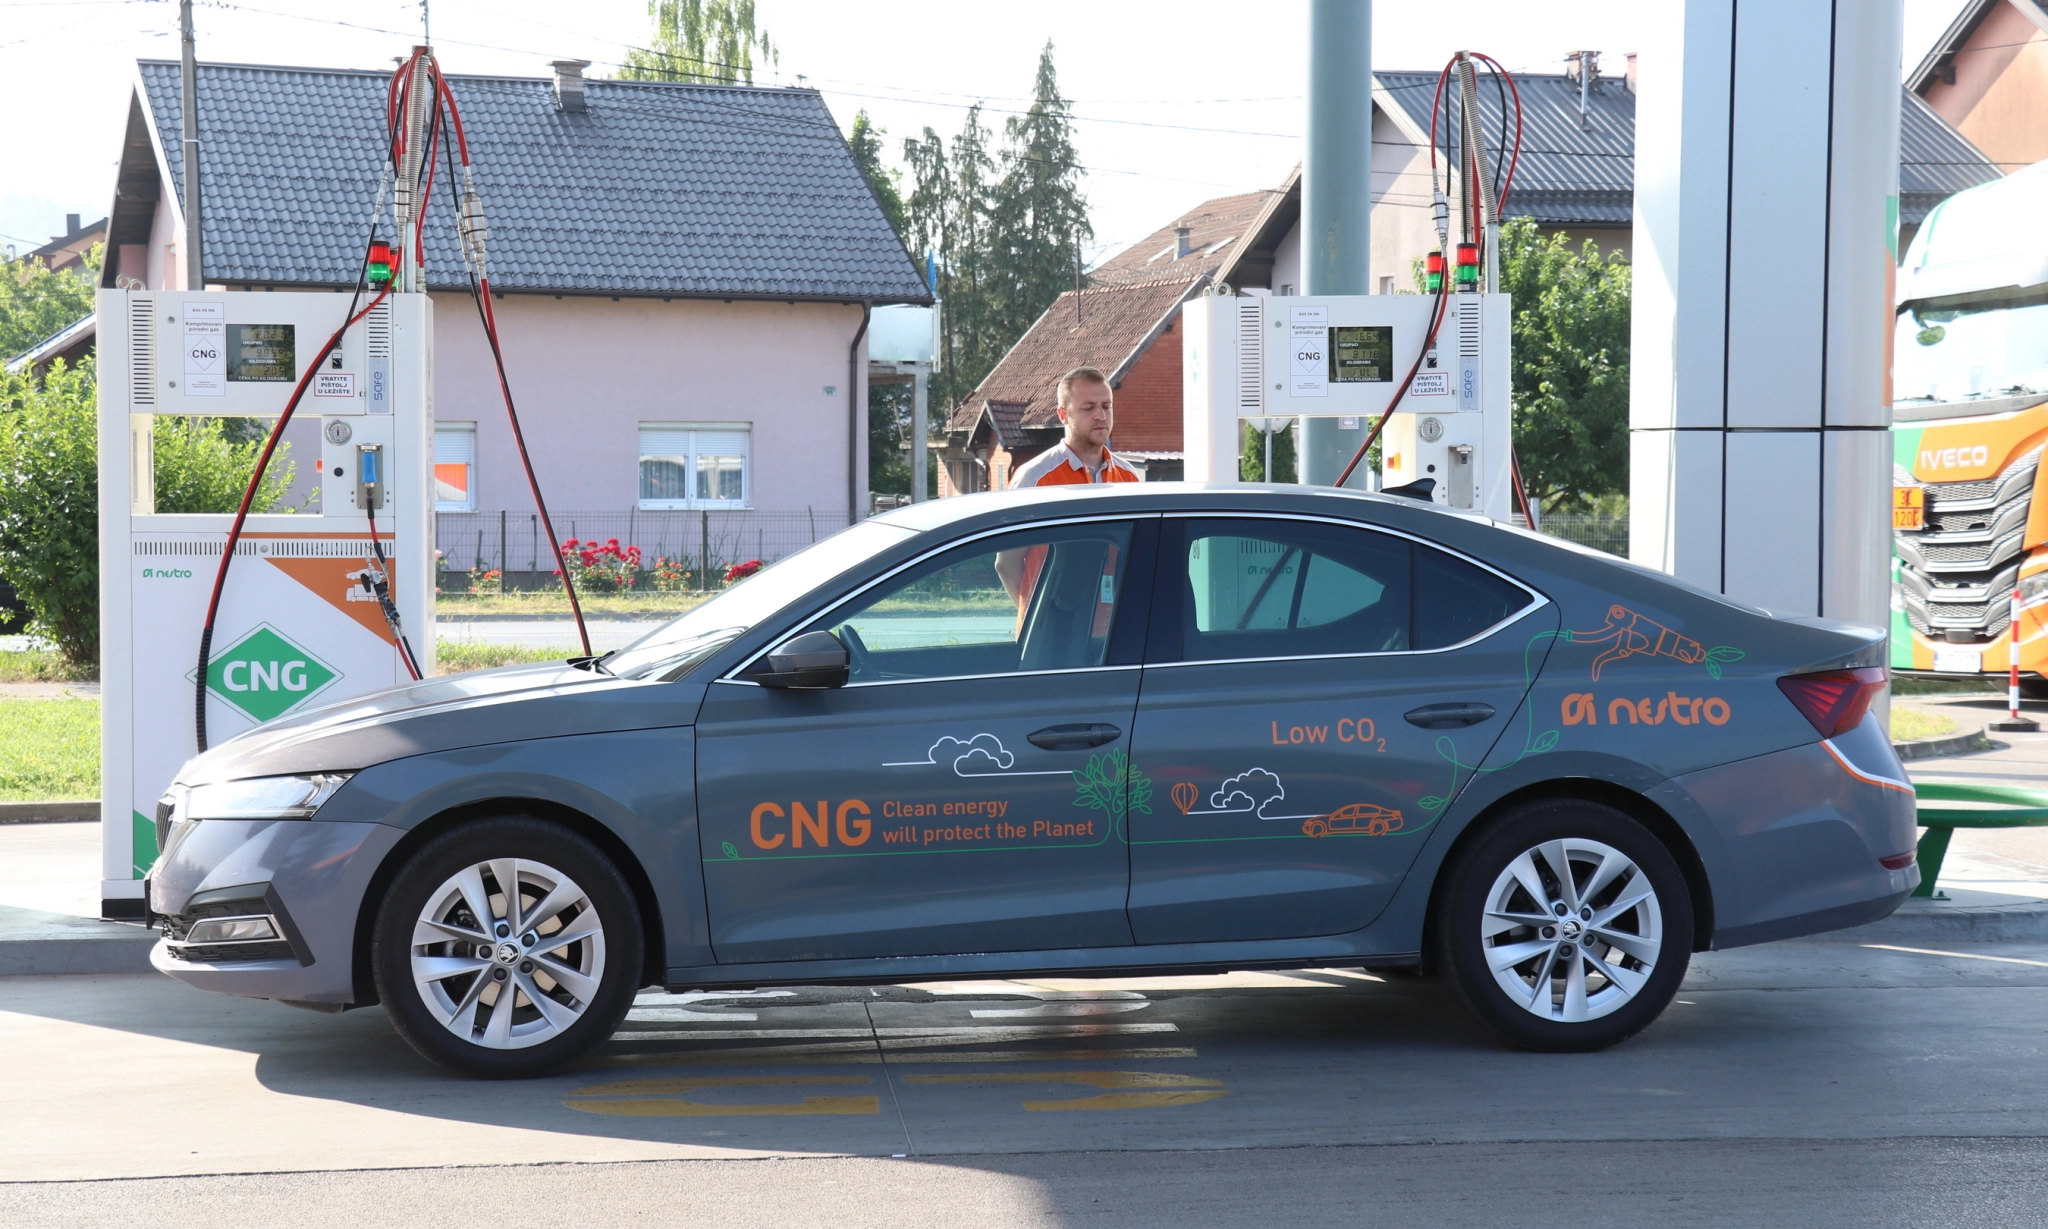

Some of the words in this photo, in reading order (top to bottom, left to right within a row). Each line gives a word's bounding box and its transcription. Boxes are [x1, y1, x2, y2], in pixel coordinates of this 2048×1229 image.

[192, 350, 216, 358] CNG
[1298, 352, 1320, 360] CNG
[1921, 445, 1987, 470] IVECO
[222, 660, 307, 692] CNG
[1271, 720, 1328, 746] Low
[882, 800, 938, 818] Clean
[943, 800, 1009, 818] energy
[749, 798, 873, 850] CNG
[882, 826, 918, 844] will
[923, 824, 992, 845] protect
[996, 822, 1027, 838] the
[1032, 820, 1094, 838] Planet
